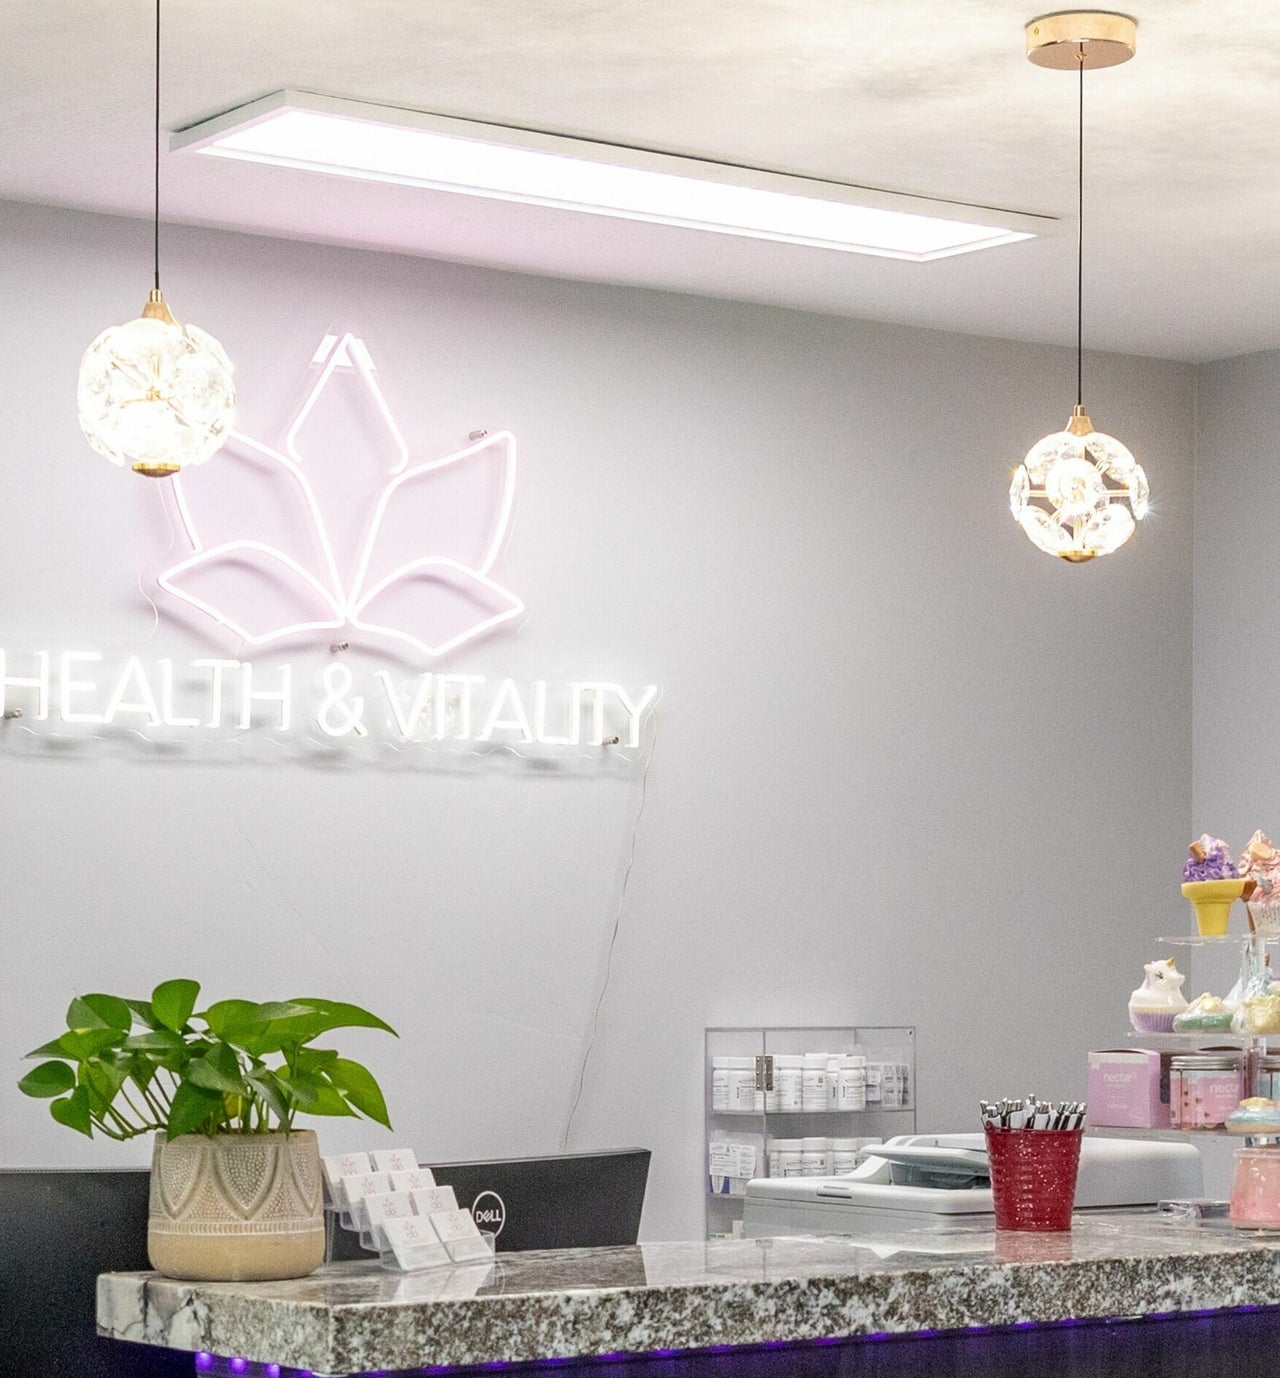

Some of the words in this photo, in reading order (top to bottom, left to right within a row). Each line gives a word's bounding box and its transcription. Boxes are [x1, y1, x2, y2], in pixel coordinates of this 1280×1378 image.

[315, 662, 368, 737] &
[374, 670, 658, 748] VITALITY
[476, 1209, 502, 1223] DELL
